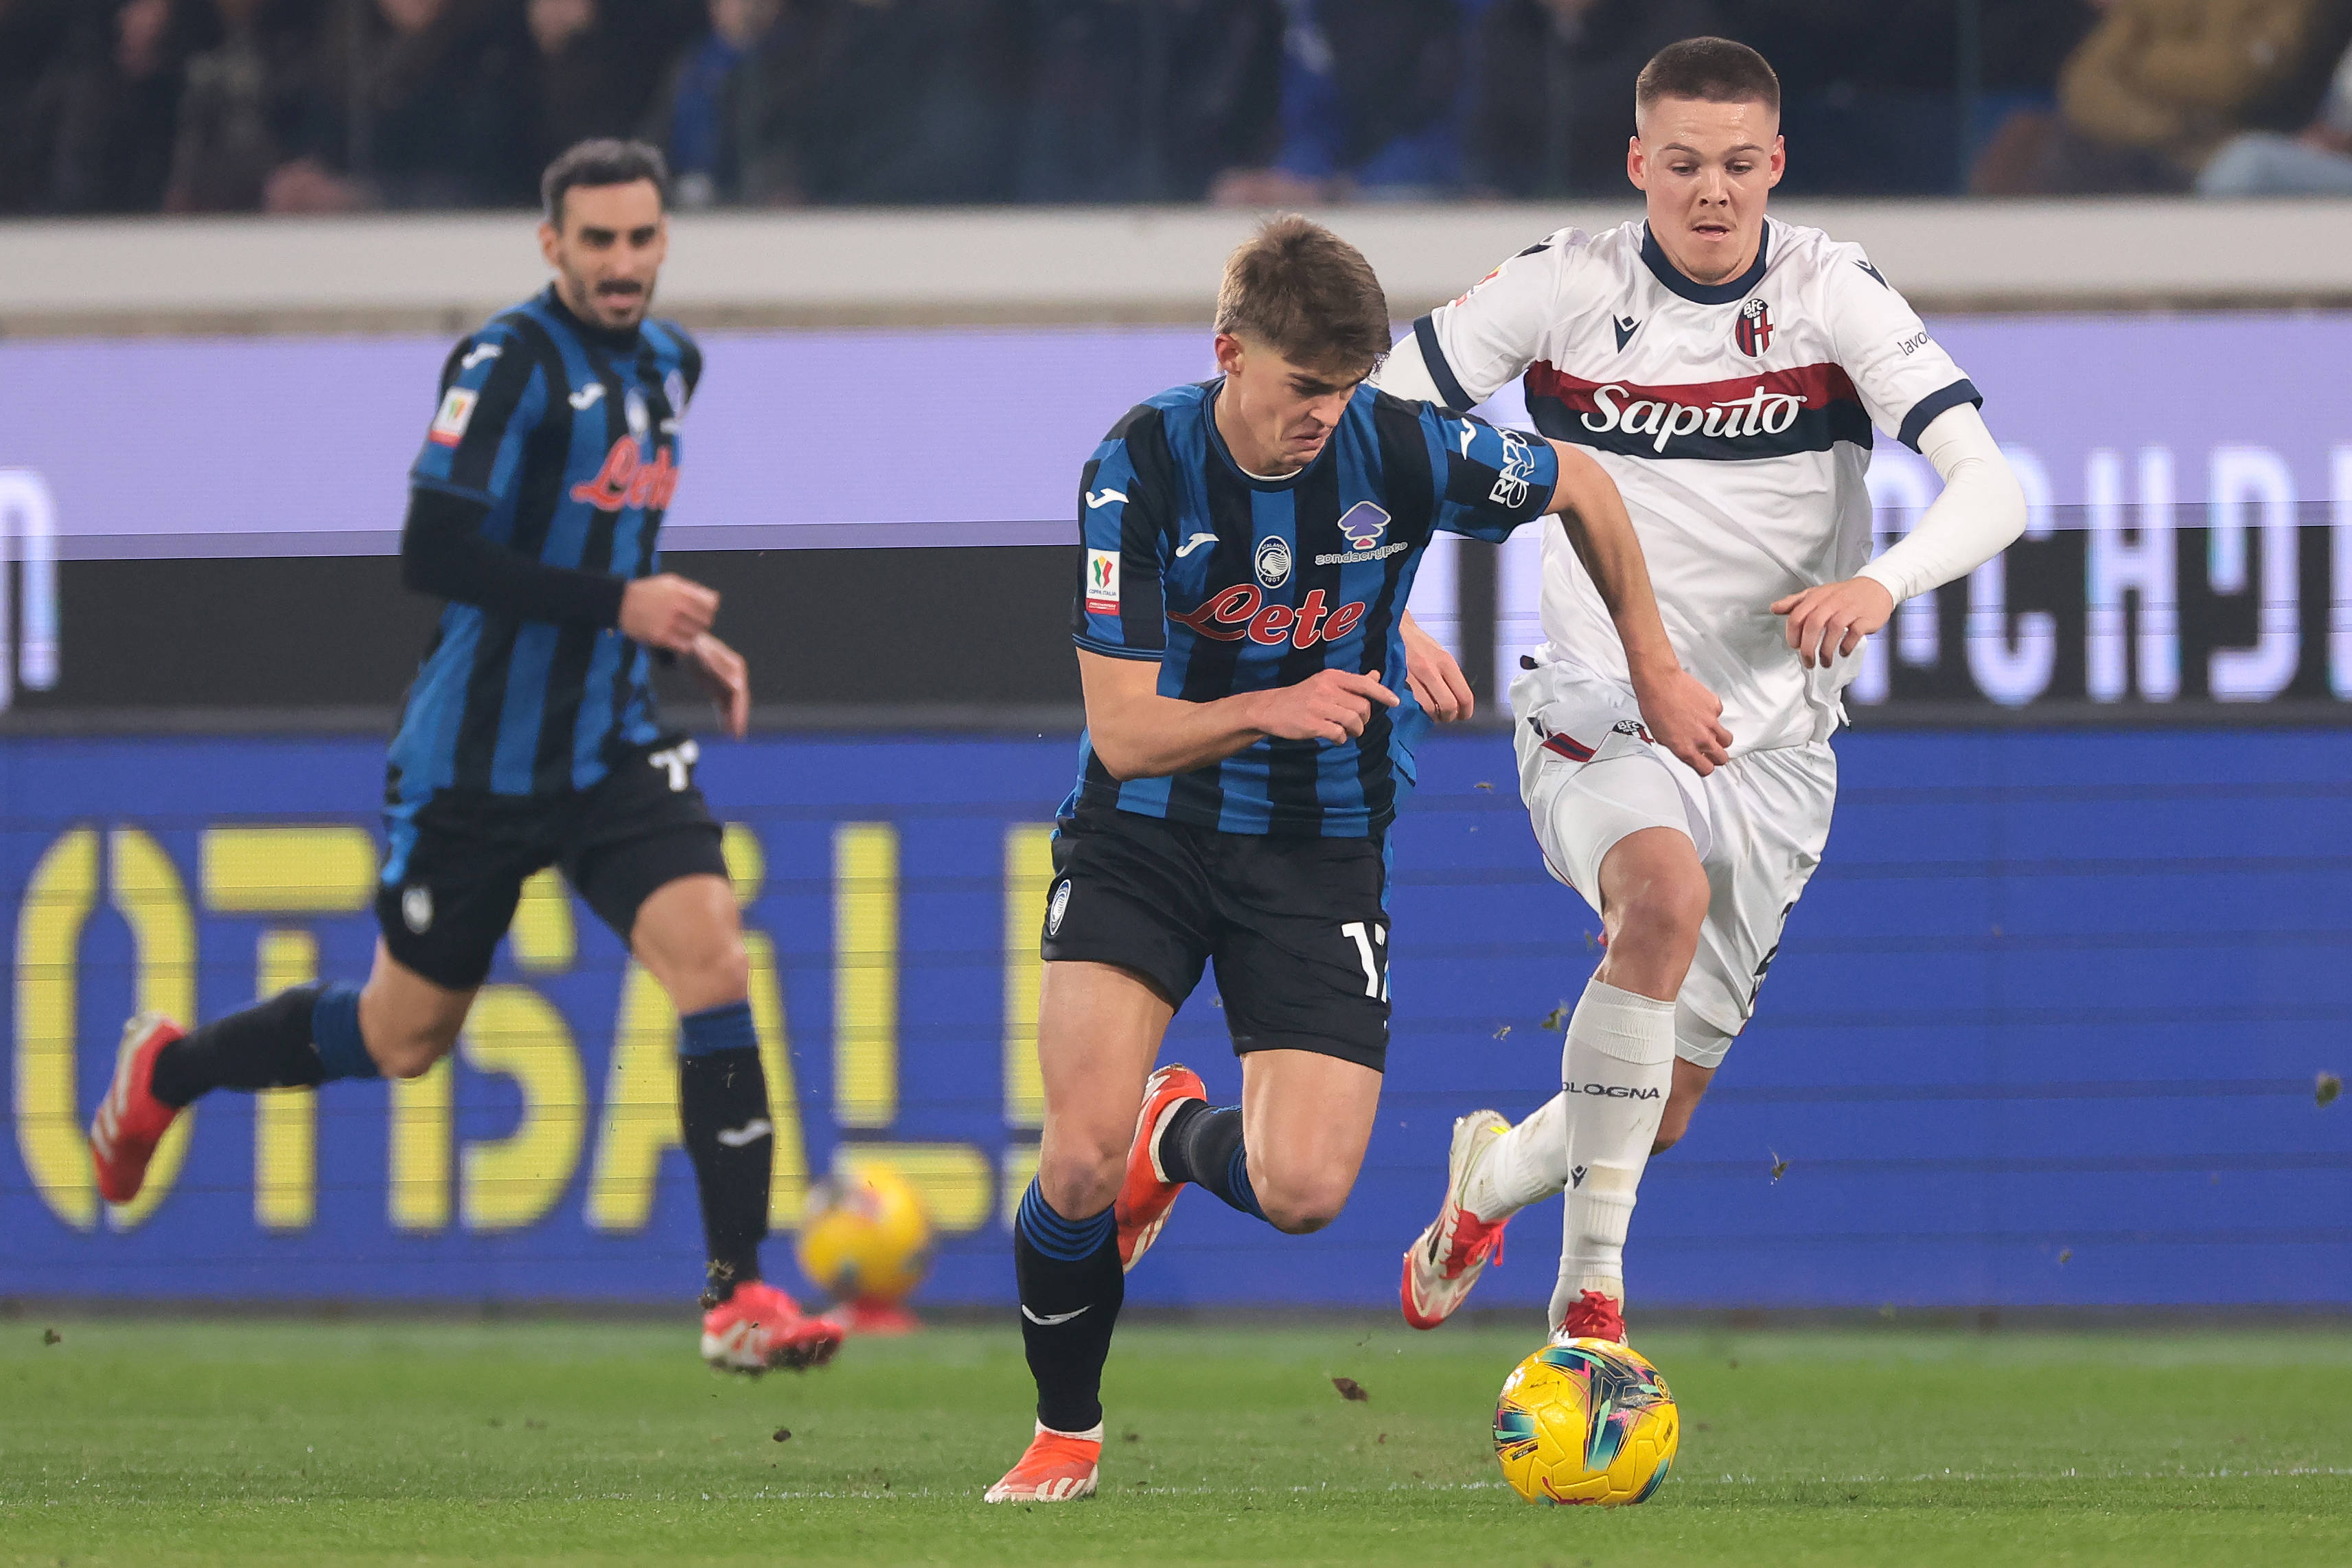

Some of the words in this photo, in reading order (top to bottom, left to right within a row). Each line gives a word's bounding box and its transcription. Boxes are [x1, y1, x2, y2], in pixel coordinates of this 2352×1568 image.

[1744, 299, 1764, 315] BFC
[1580, 384, 1808, 453] Saputo
[1315, 542, 1408, 565] zondacrypto
[1166, 584, 1365, 649] Lete
[1617, 721, 1639, 730] BFC
